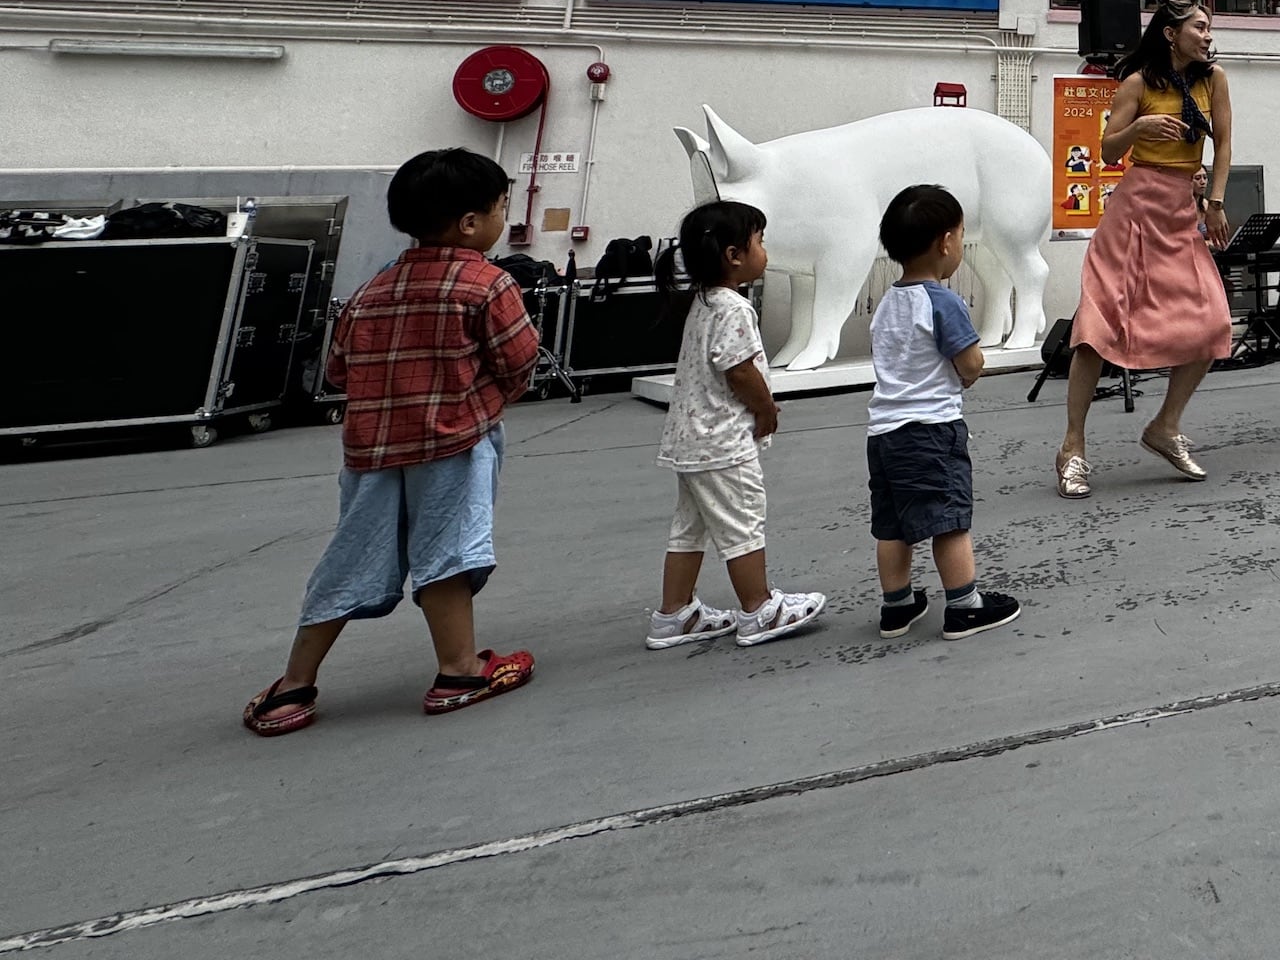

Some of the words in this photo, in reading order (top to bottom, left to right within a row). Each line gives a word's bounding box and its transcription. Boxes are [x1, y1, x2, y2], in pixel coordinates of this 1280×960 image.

[1064, 107, 1093, 118] 2024
[522, 163, 536, 171] FIR
[539, 162, 558, 171] HOSE
[559, 162, 577, 171] REEL
